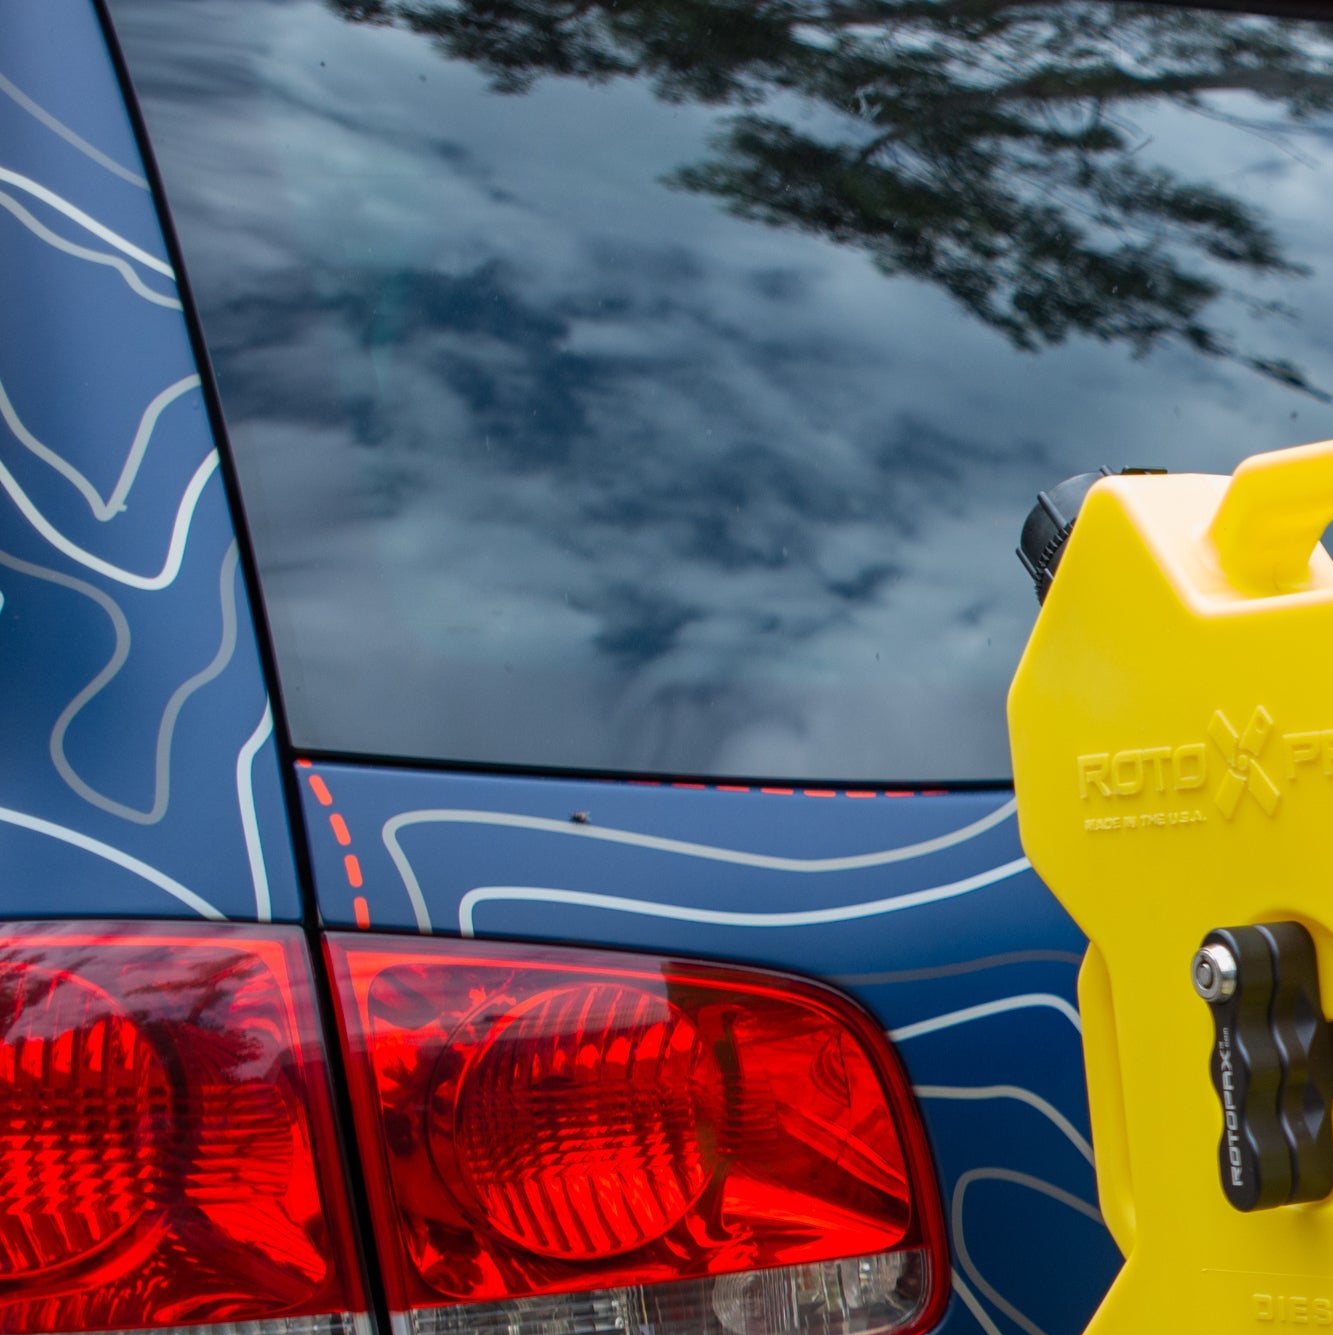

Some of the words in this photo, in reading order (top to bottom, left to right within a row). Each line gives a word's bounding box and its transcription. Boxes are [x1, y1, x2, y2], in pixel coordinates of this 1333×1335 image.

[1077, 743, 1206, 799] ROTO
[1084, 816, 1121, 831] MADE
[1123, 815, 1137, 829] IN
[1140, 812, 1166, 827] THE
